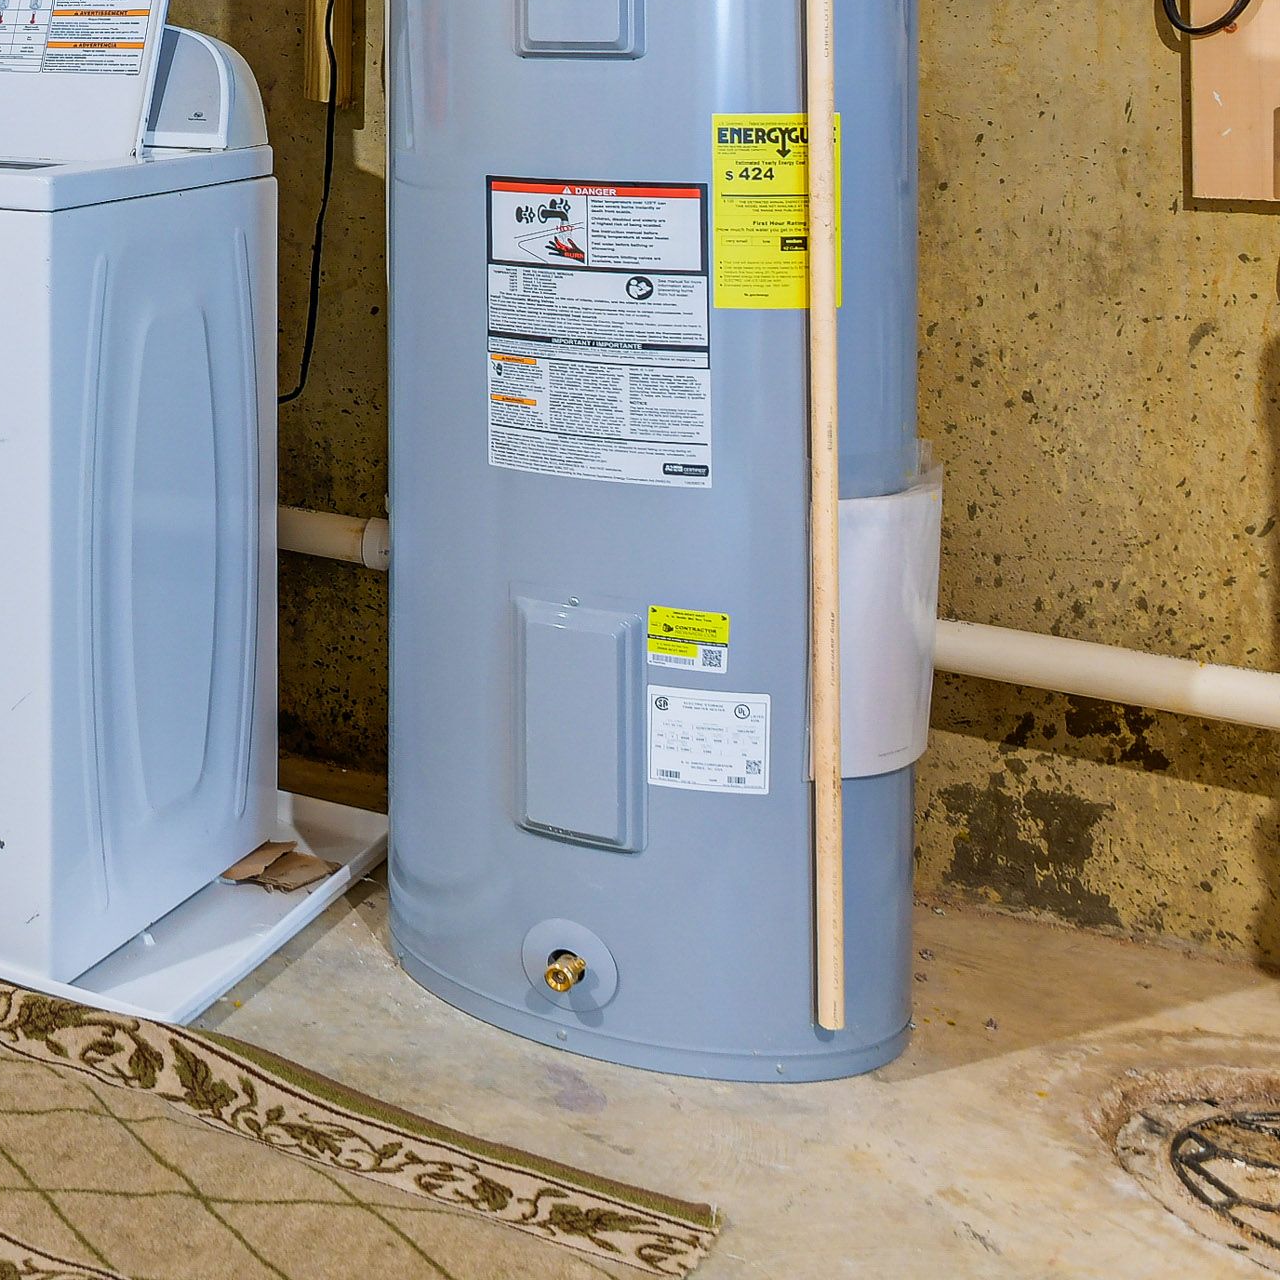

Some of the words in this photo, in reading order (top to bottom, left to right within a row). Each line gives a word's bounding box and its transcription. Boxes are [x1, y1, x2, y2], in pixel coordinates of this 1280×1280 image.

[718, 127, 808, 144] ENERGYGU
[739, 168, 774, 180] 424
[575, 187, 617, 196] DANGER
[564, 252, 584, 260] BURN
[552, 338, 591, 346] IMPORTANT
[596, 341, 642, 350] IMPORTANTE
[675, 625, 716, 633] CONTRACTOR
